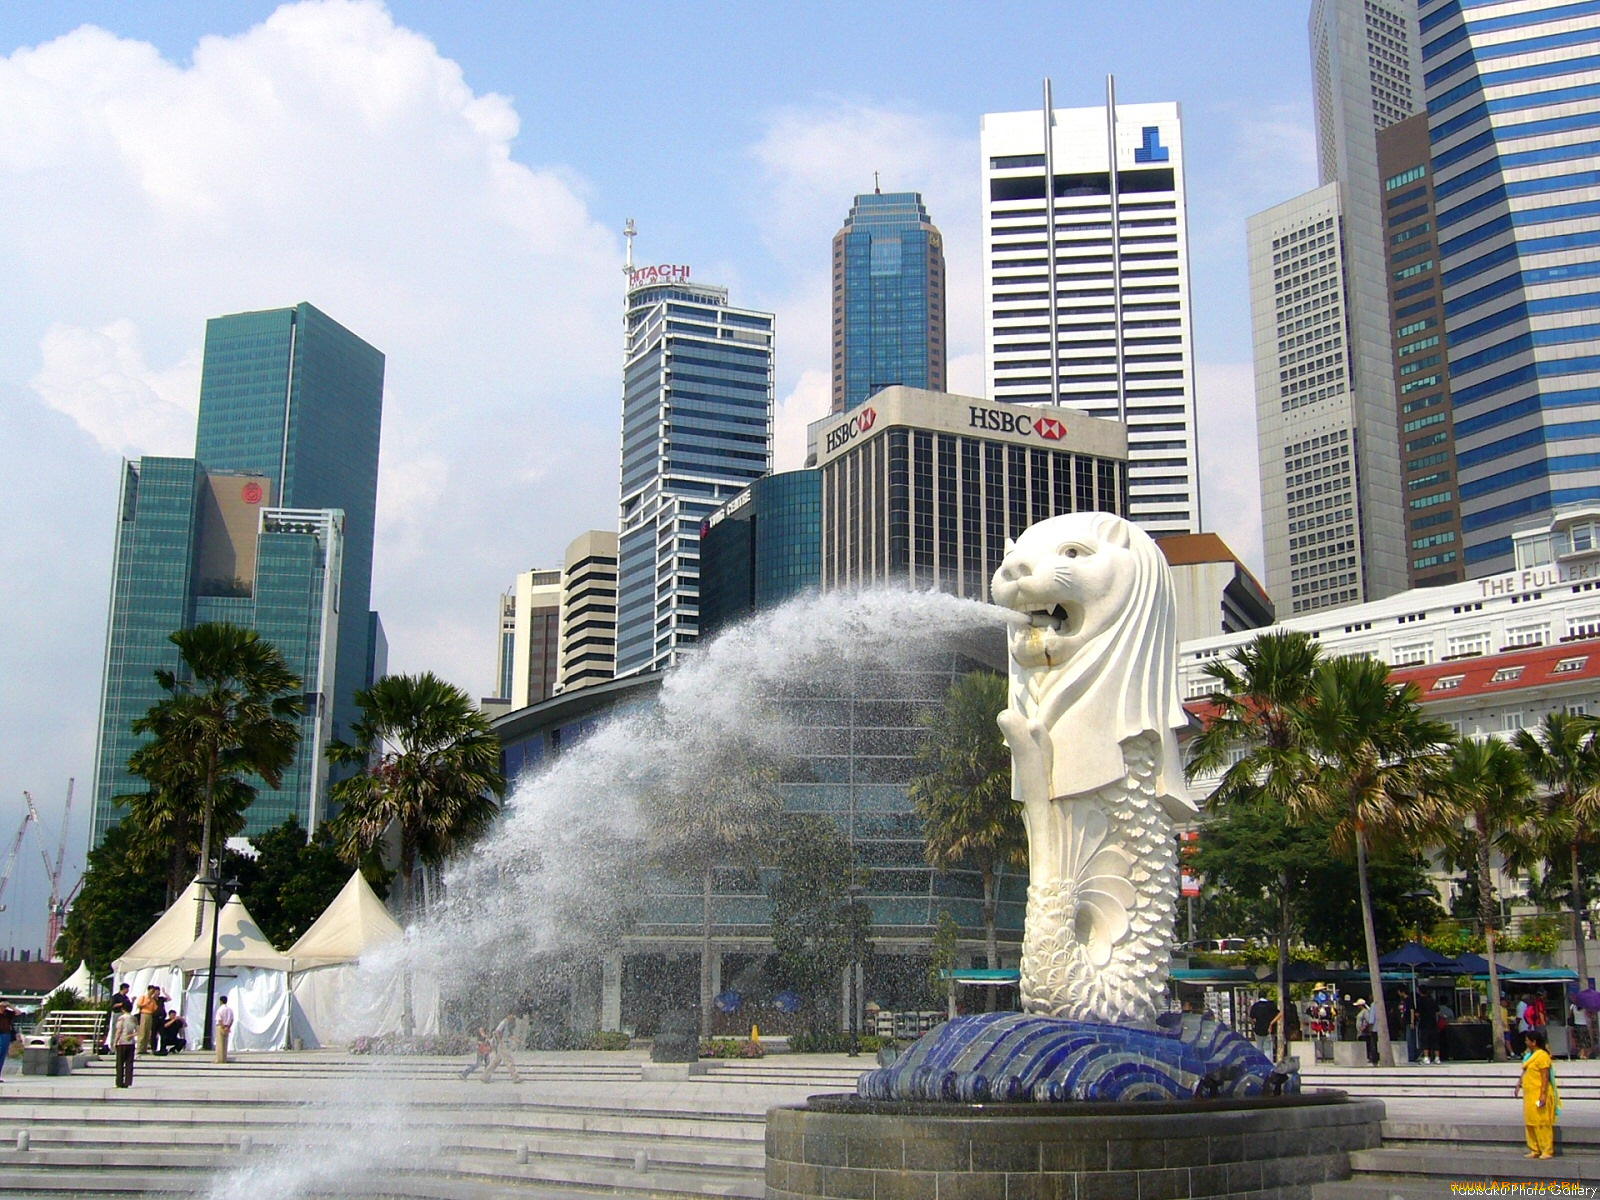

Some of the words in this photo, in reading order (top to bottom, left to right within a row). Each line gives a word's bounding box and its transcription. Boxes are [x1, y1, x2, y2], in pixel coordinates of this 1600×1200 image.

[630, 264, 690, 285] HITACHI
[969, 406, 1032, 436] HSBC
[826, 416, 858, 453] HSBC
[1478, 577, 1515, 597] THE
